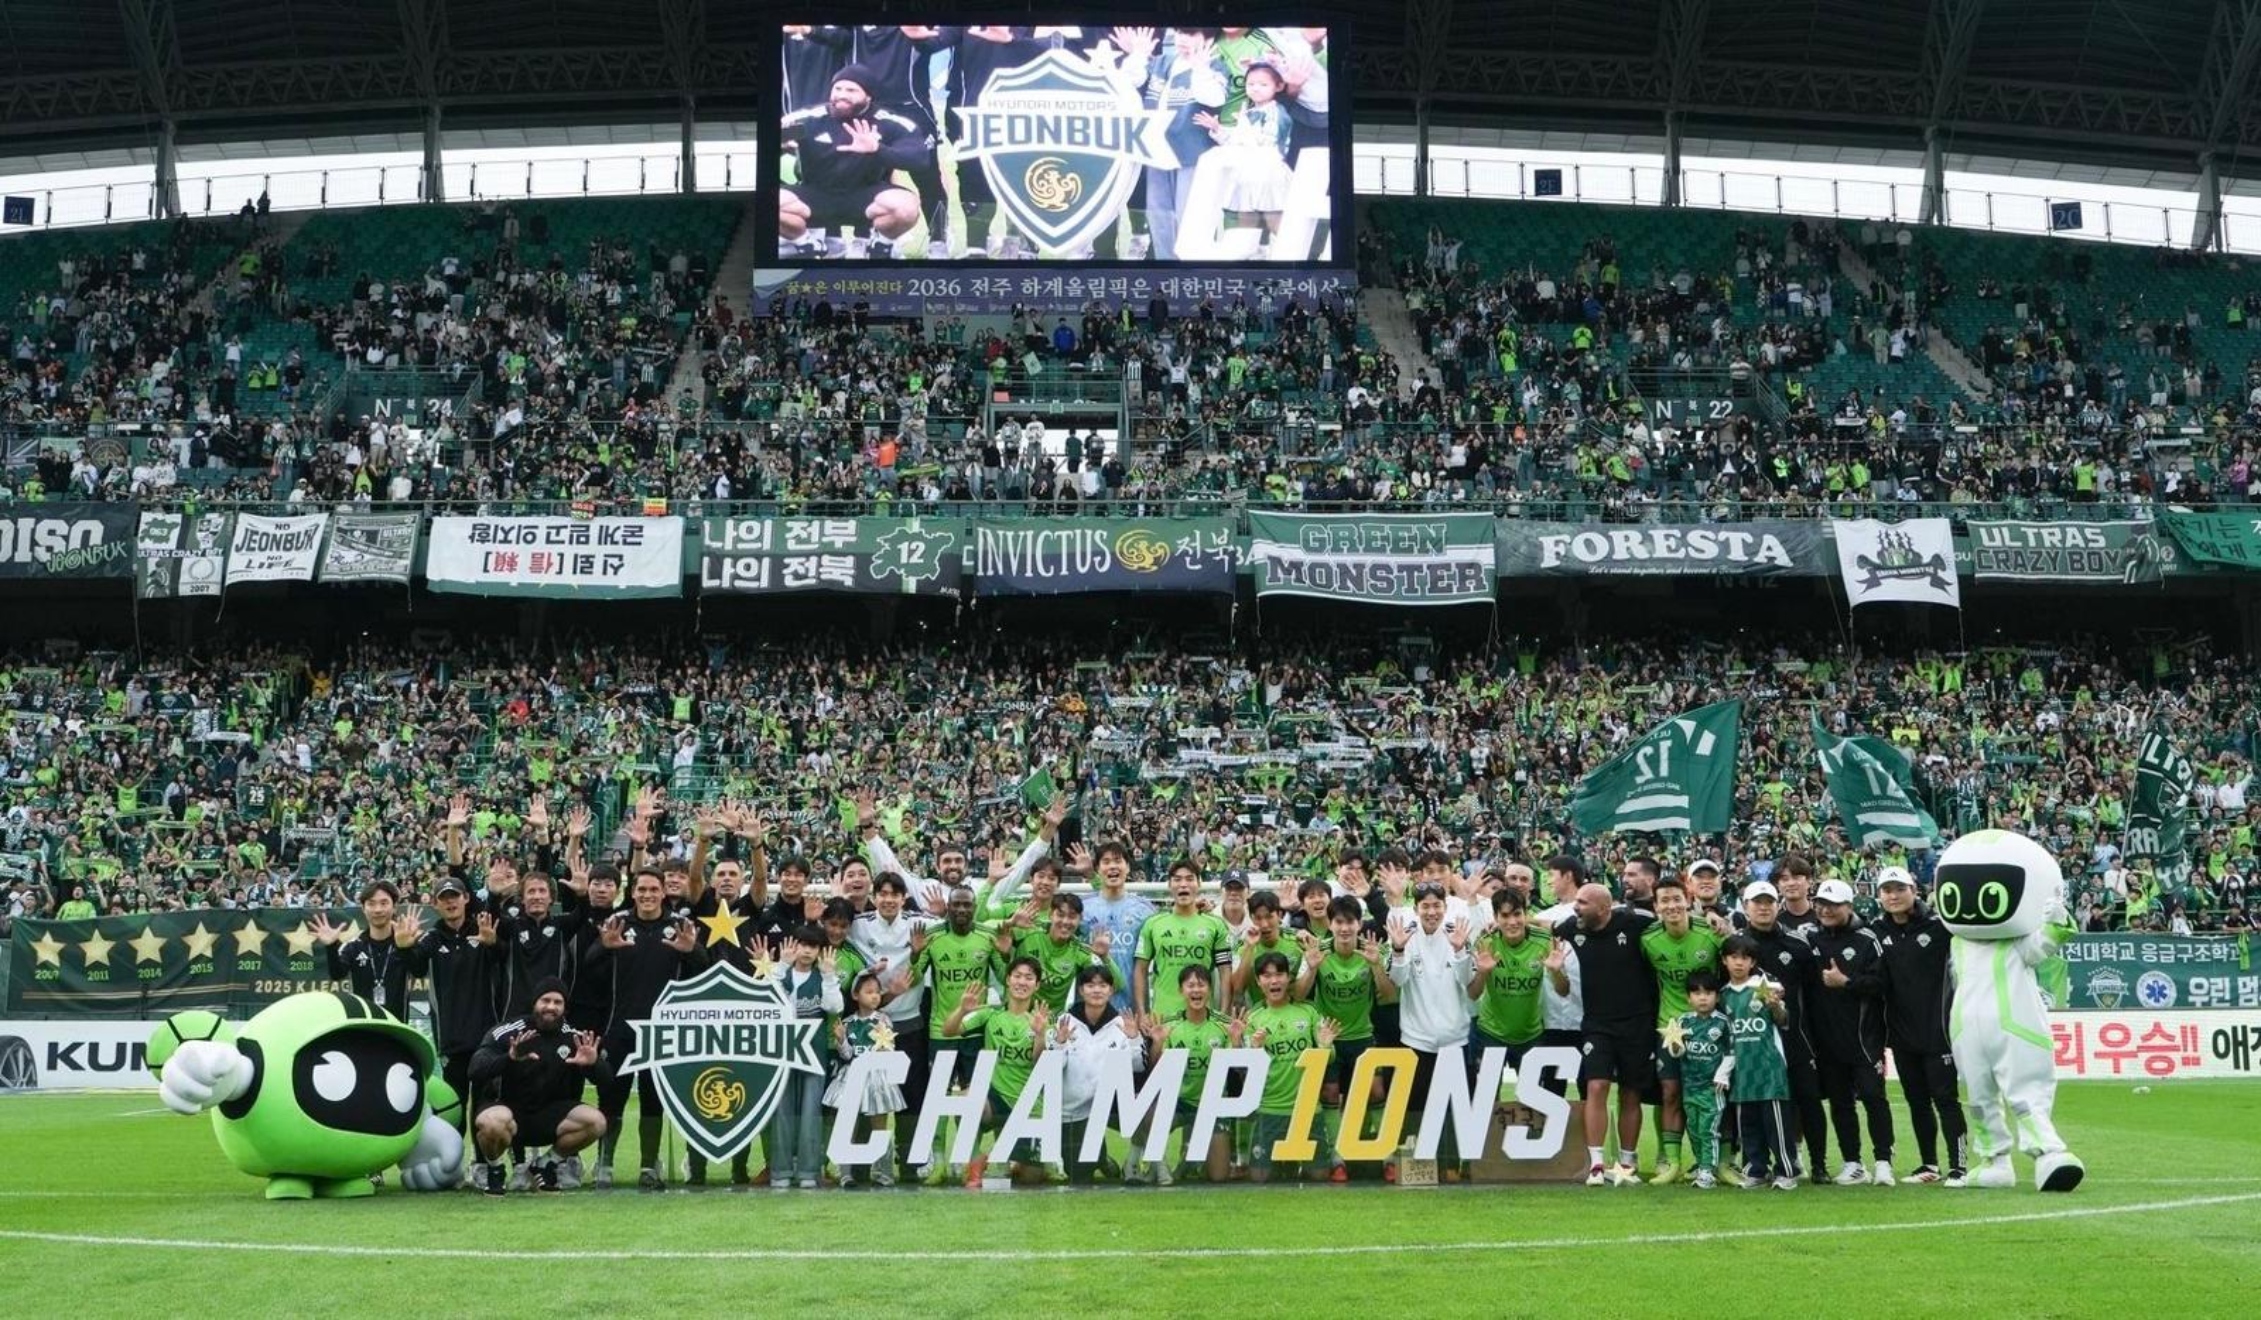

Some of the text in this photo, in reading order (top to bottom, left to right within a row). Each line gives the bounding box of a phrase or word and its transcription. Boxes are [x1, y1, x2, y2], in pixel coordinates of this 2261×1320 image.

[987, 98, 1117, 111] HYUNDAI MOTORS
[959, 113, 1151, 157] JEONBUK
[908, 278, 961, 297] 2036
[970, 277, 1012, 297] 전주
[1020, 277, 1151, 299] 하계올림픽은
[1160, 277, 1246, 299] 대한민국
[1656, 399, 1673, 419] N
[1708, 399, 1734, 419] 22
[235, 522, 320, 552] JEONBUK
[275, 522, 290, 530] NO
[468, 522, 539, 545] 의지함
[703, 519, 858, 550] 나의 전부
[1981, 526, 2106, 548] ULTRAS
[1300, 522, 1448, 556] GREEN
[1538, 528, 1794, 569] FORESTA
[897, 541, 925, 564] 12
[976, 526, 1111, 578] INVICTUS
[1976, 548, 2121, 574] CRAZY BOY
[701, 555, 855, 588] 나의 전북
[1266, 555, 1489, 597] MONSTER
[1160, 945, 1205, 960] NEXO
[2058, 942, 2136, 963] 전대학교
[87, 969, 110, 980] 2011
[138, 967, 162, 979] 2014
[189, 961, 214, 975] 2015
[238, 959, 262, 972] 2017
[290, 960, 314, 972] 2018
[939, 968, 983, 983] NEXO
[255, 979, 292, 994] 2025
[296, 980, 310, 994] K
[1326, 984, 1367, 998] NEXO
[1494, 976, 1542, 991] NEXO
[2188, 976, 2231, 1007] 우린
[660, 1009, 782, 1021] HYUNDAI MOTORS
[629, 1022, 811, 1066] JEONBUK
[2094, 1021, 2201, 1076] 우승!!
